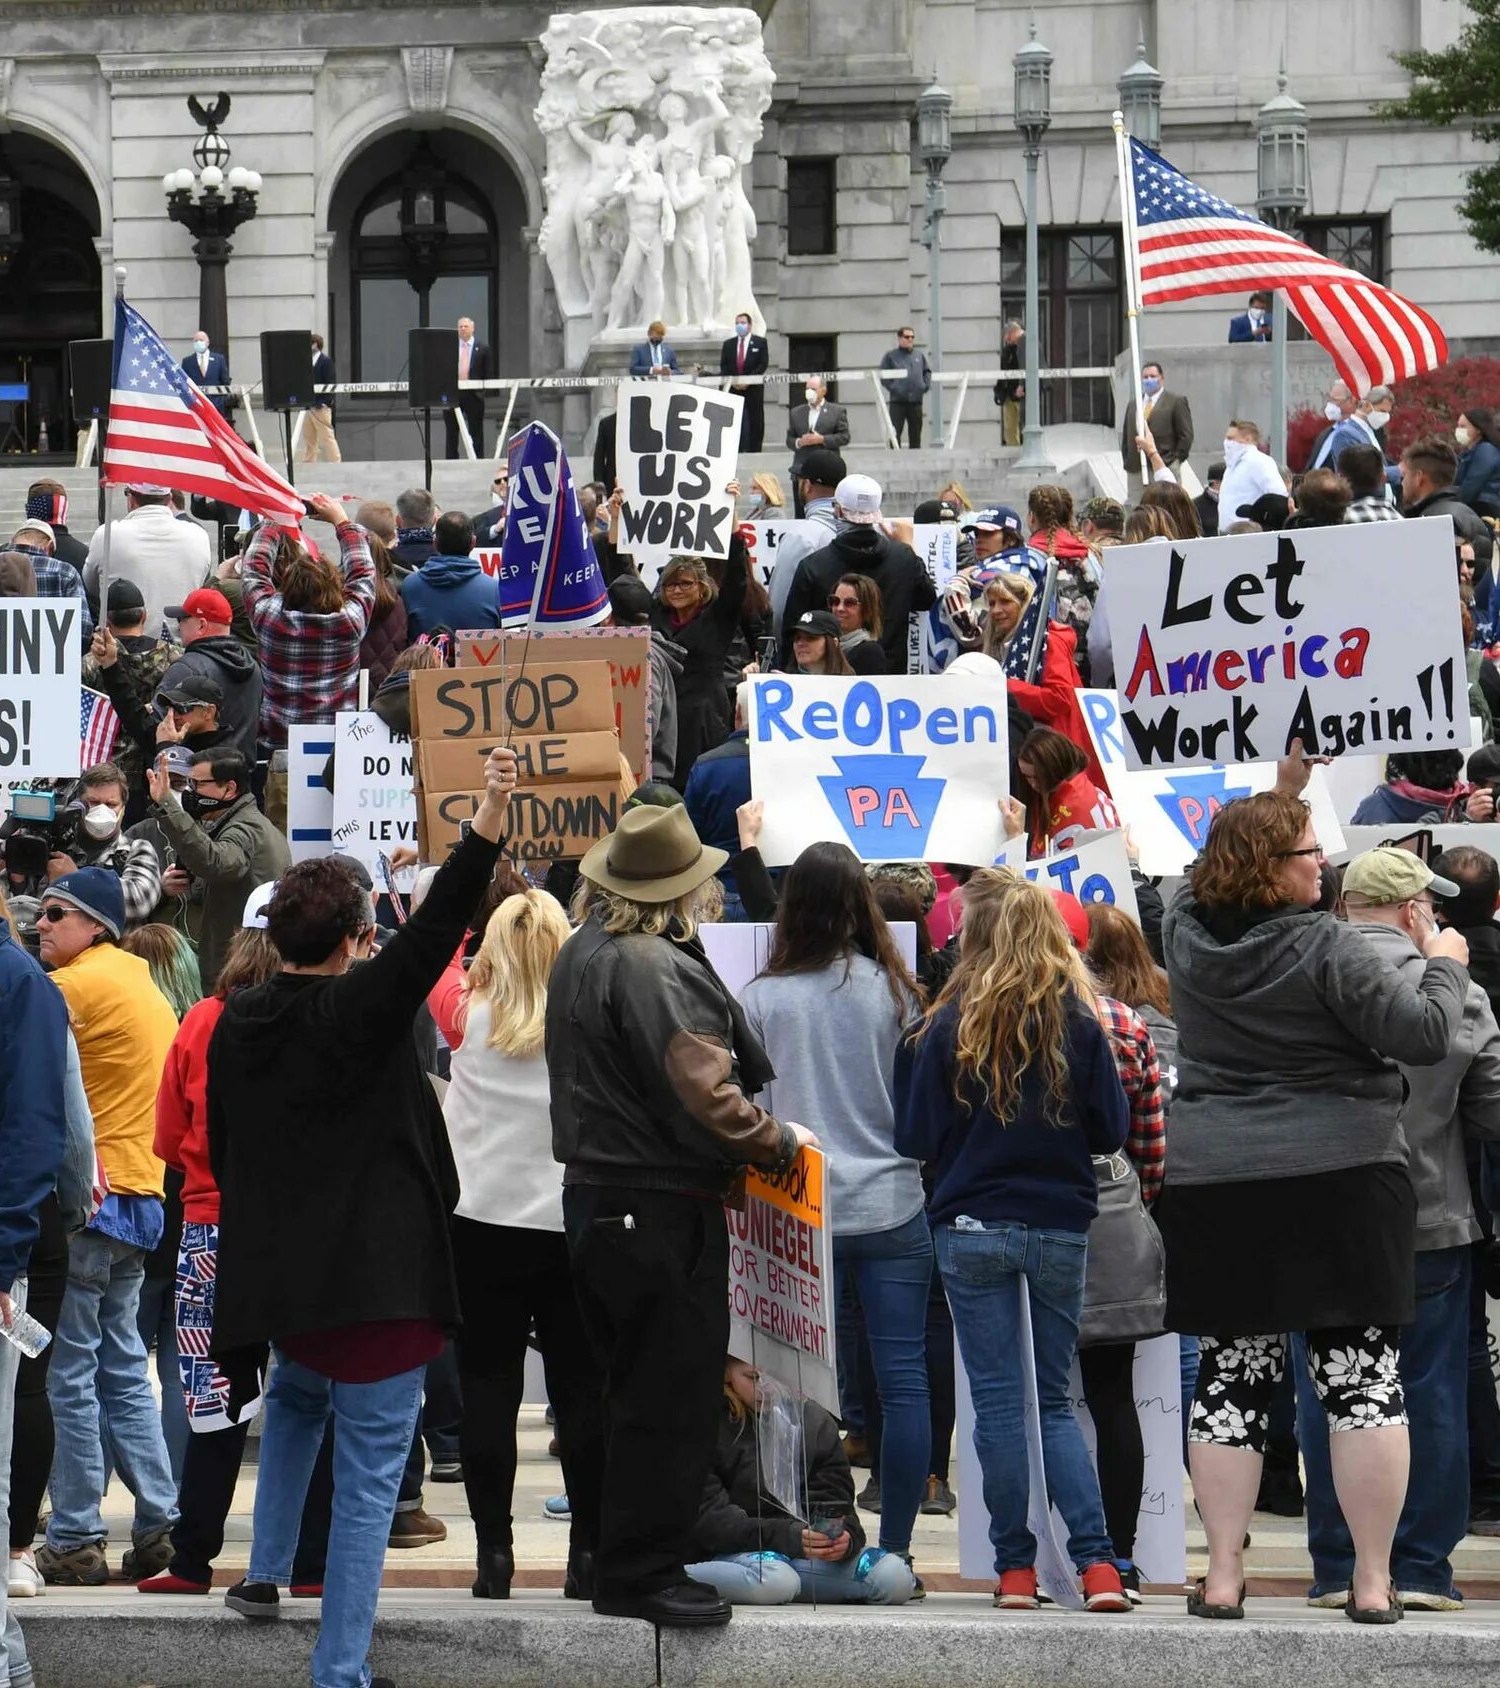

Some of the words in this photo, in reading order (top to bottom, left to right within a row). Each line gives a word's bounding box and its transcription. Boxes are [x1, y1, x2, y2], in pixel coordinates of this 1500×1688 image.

[551, 377, 587, 386] CAPITOL
[763, 374, 799, 383] CAPITOL
[630, 394, 735, 458] LET
[638, 454, 711, 500] US
[621, 499, 732, 556] WORK
[1161, 534, 1306, 630] Let
[1124, 623, 1371, 704] America
[436, 674, 579, 737] STOP
[754, 679, 997, 754] ReOpen
[348, 723, 375, 742] The
[1121, 695, 1260, 765] Work
[363, 756, 391, 776] DO
[478, 739, 568, 777] HE
[845, 785, 922, 828] PA
[333, 819, 361, 842] THIS
[767, 1258, 820, 1318] BETTER
[183, 1318, 210, 1327] BRAVE
